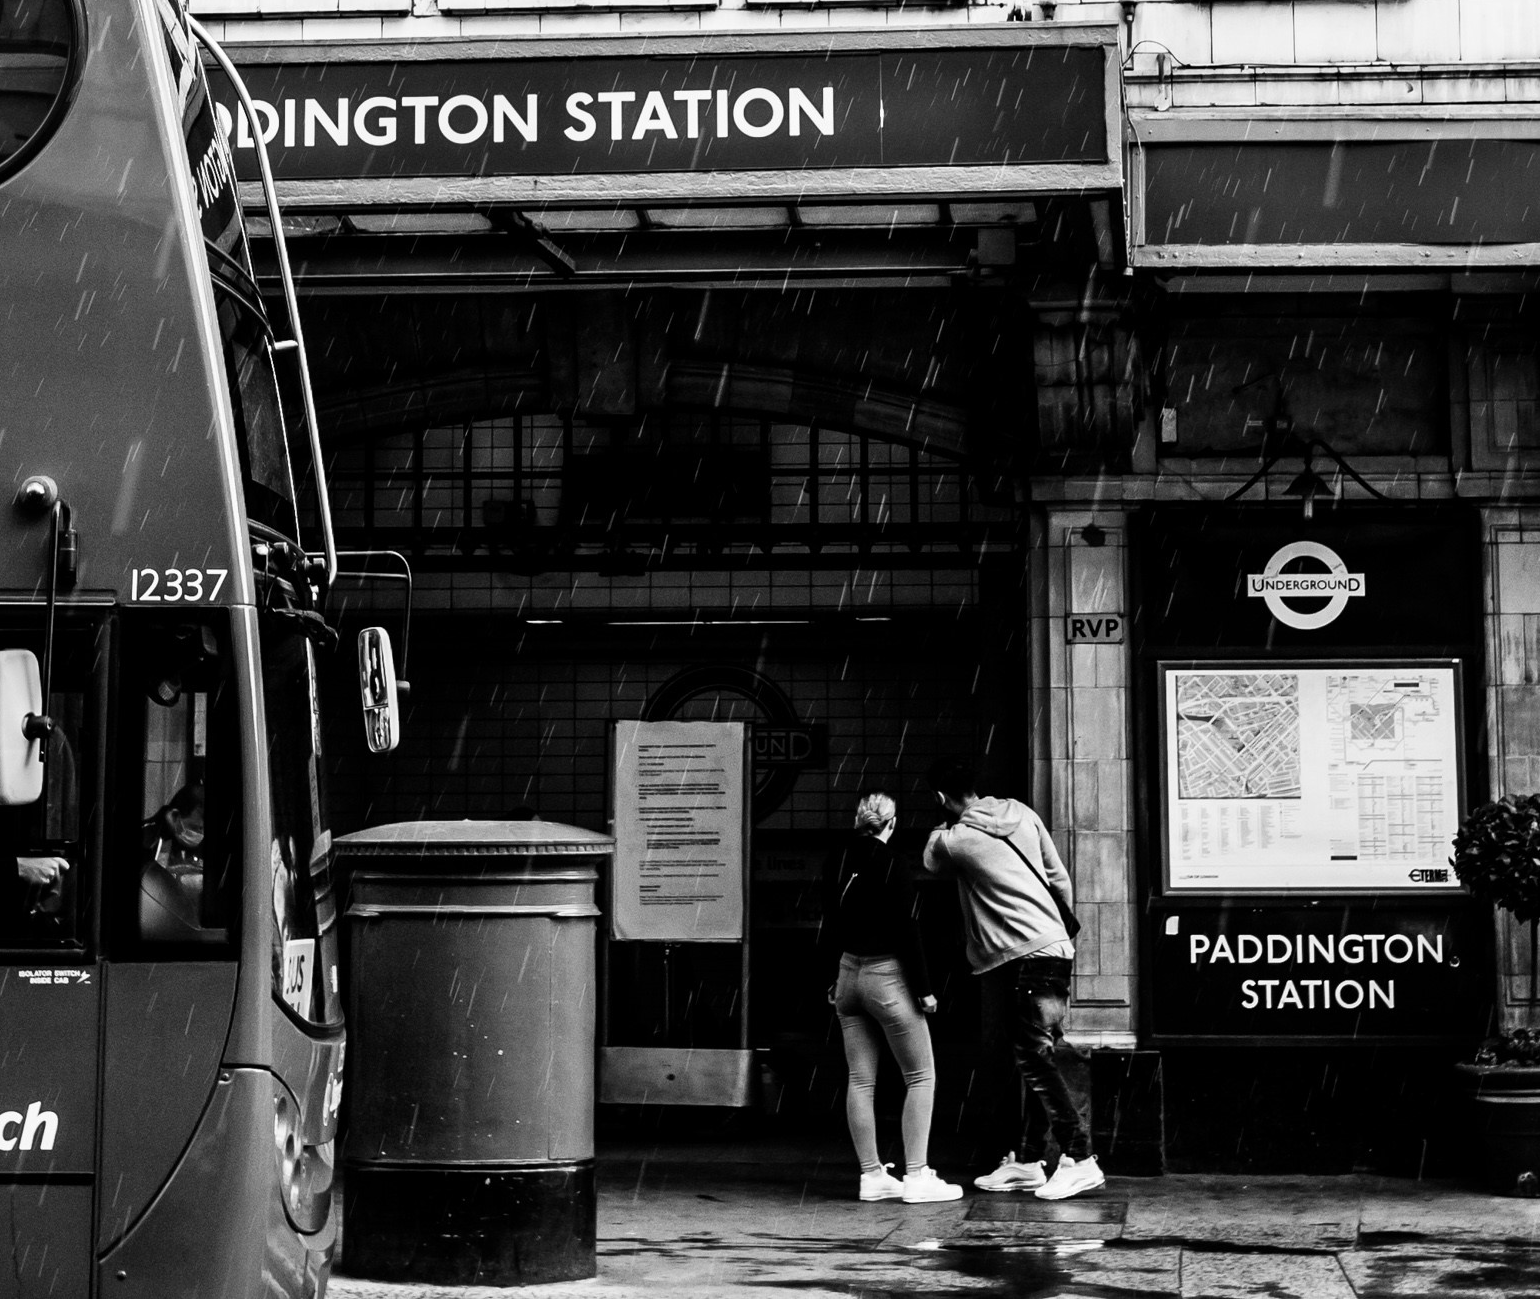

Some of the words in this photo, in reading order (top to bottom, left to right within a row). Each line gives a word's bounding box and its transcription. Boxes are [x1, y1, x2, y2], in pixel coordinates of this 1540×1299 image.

[563, 86, 835, 143] STATION
[130, 568, 229, 602] 12337
[1251, 576, 1361, 594] UNDERGROUND
[1071, 617, 1119, 640] RVP
[1189, 934, 1444, 965] PADDINGTON
[1240, 979, 1396, 1010] STATION
